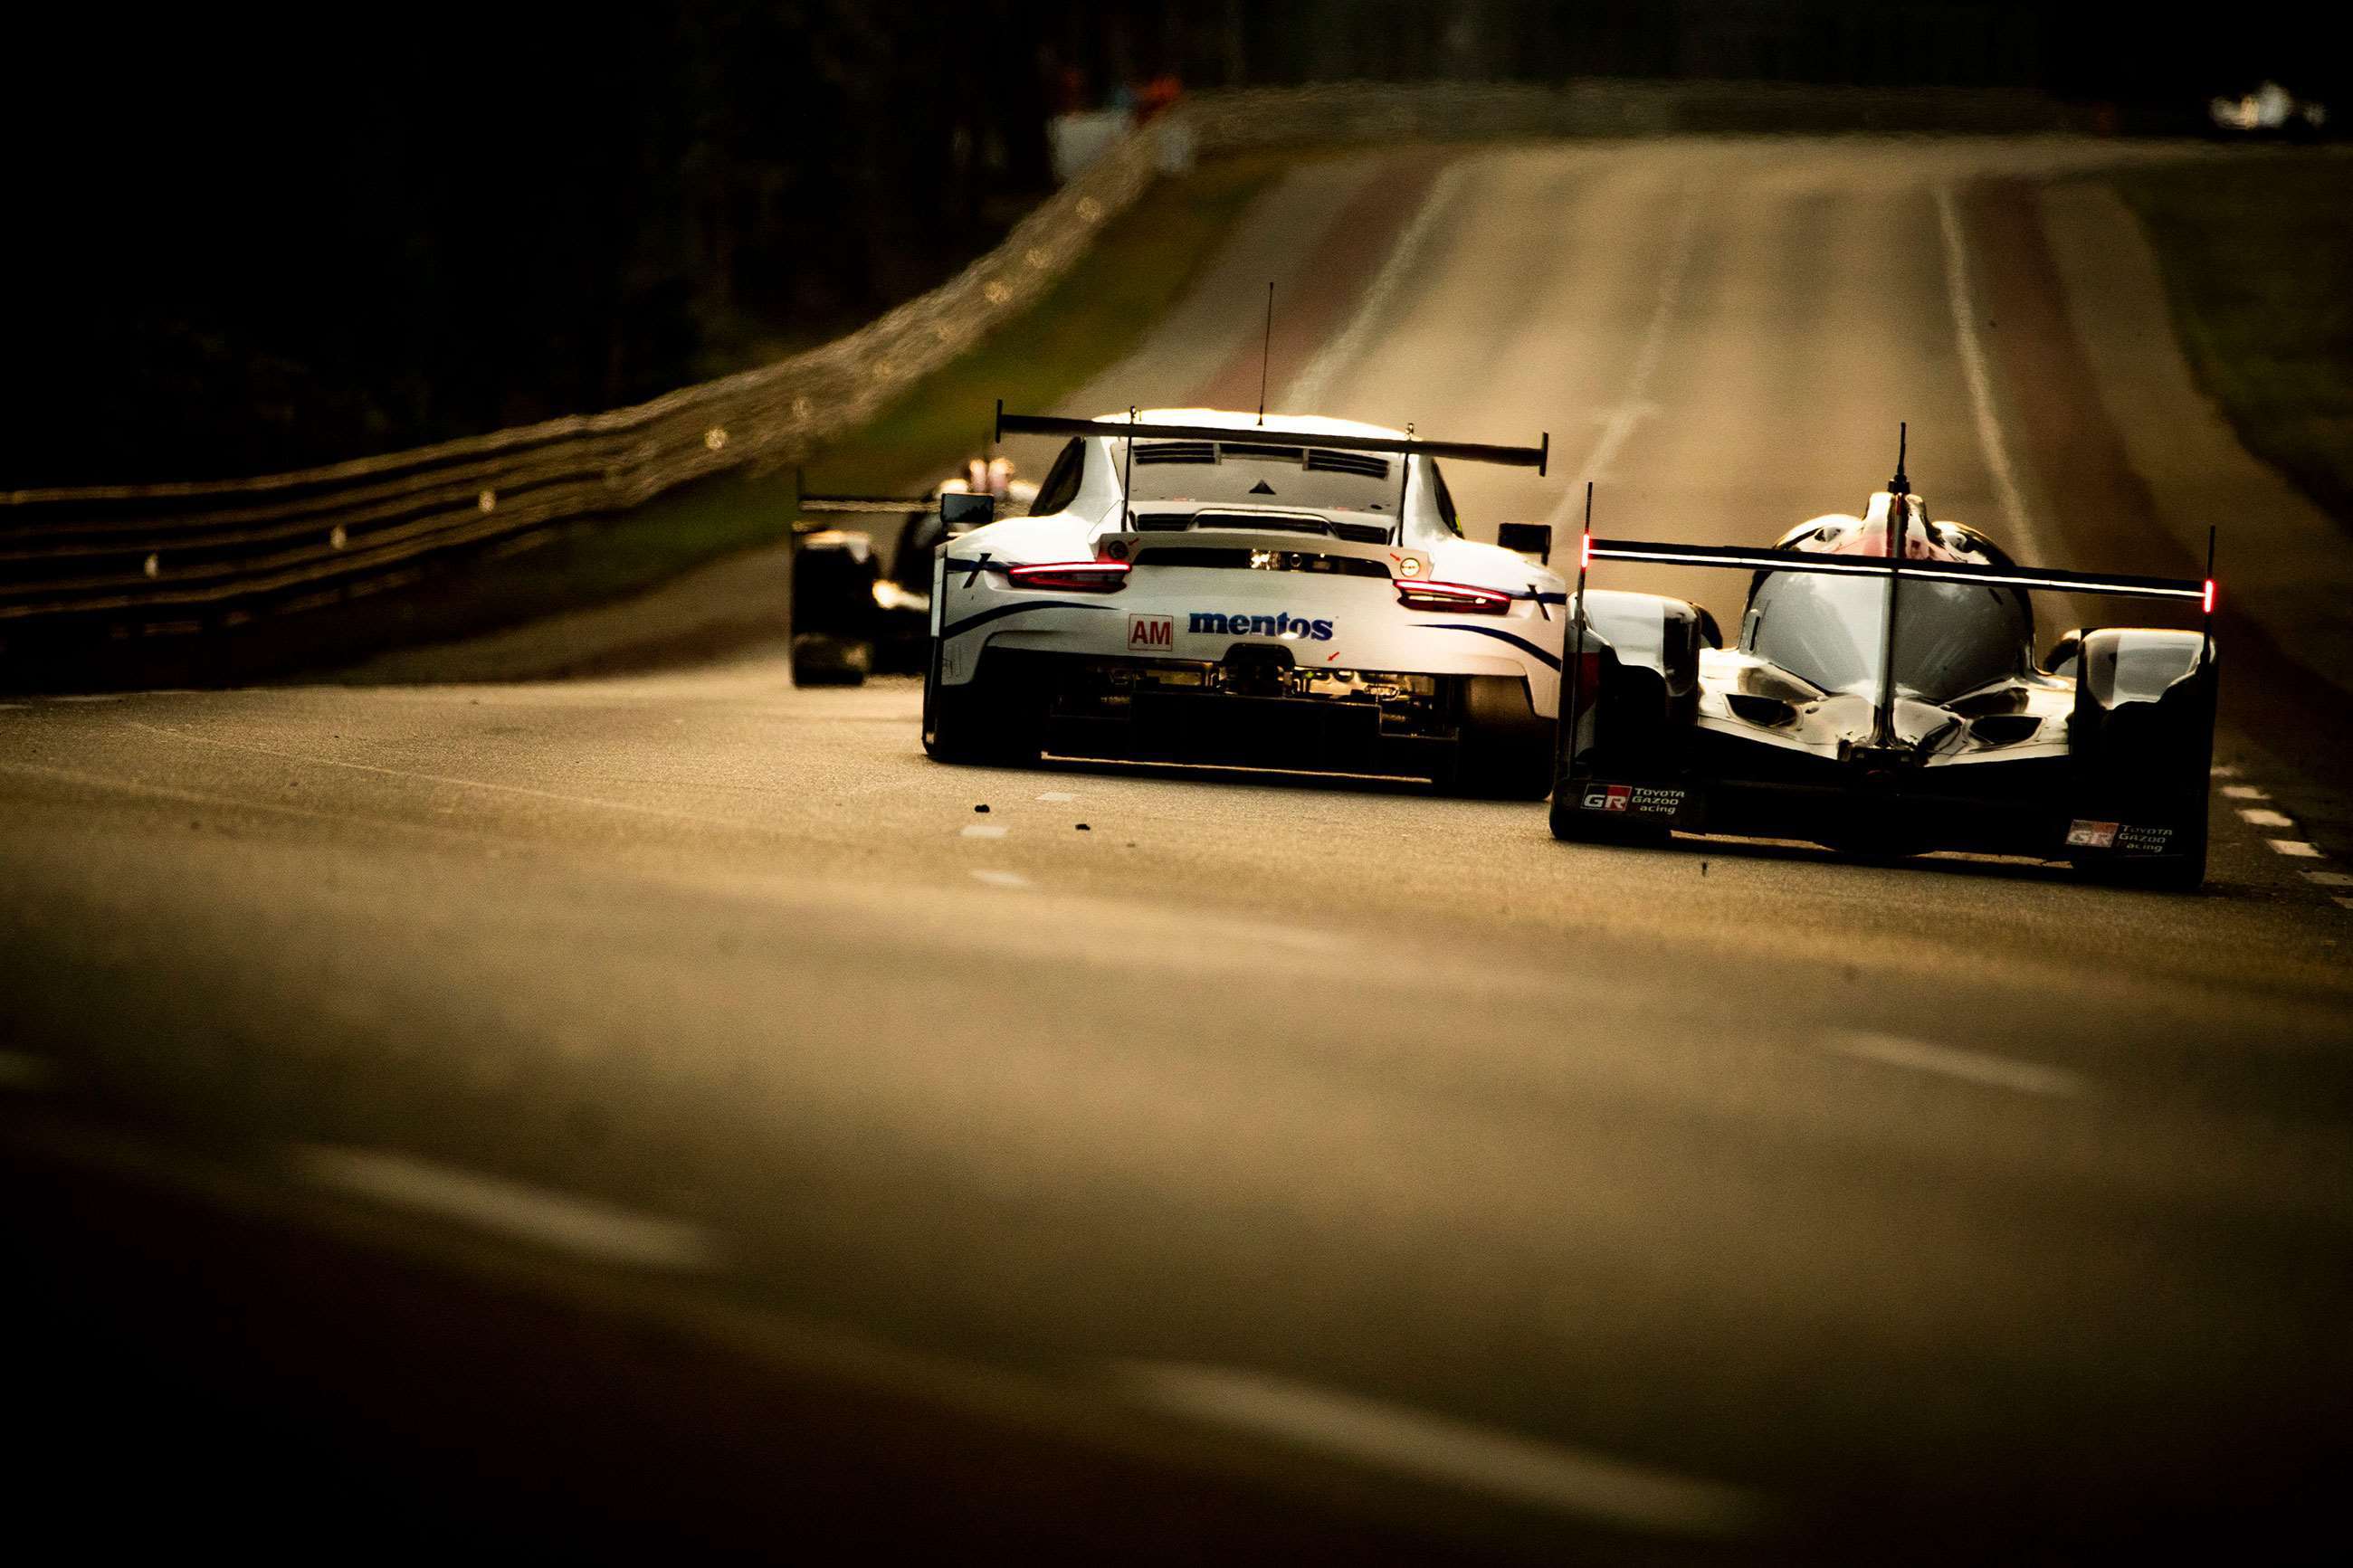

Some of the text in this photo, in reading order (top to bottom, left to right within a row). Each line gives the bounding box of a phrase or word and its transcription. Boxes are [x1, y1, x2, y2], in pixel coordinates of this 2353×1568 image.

[1131, 621, 1170, 645] AM
[1188, 612, 1333, 641] mentos
[1634, 787, 1685, 798] TOYOTA
[1584, 794, 1626, 809] GR
[2121, 824, 2172, 835] TOYOTA
